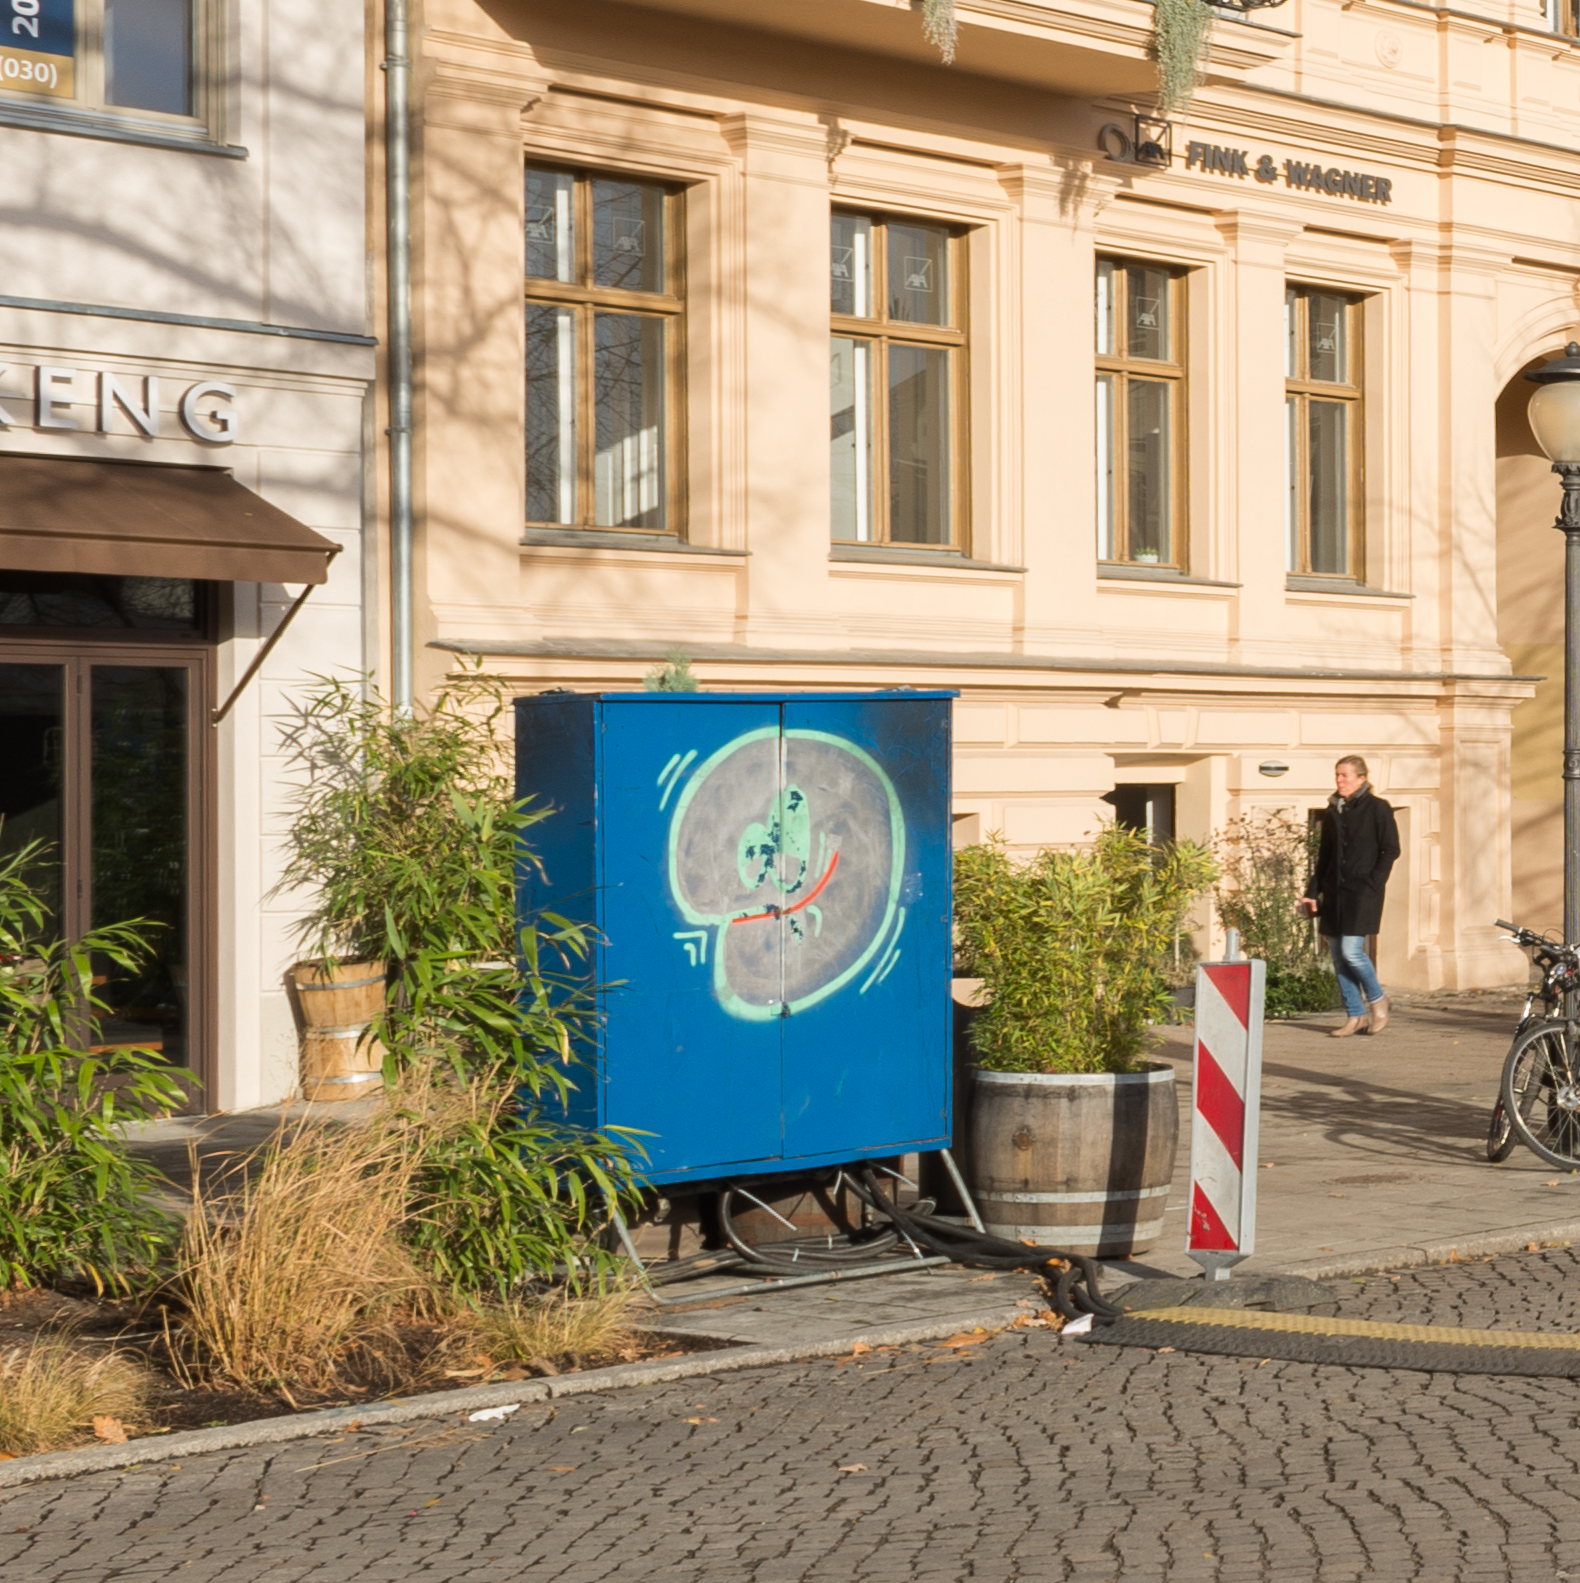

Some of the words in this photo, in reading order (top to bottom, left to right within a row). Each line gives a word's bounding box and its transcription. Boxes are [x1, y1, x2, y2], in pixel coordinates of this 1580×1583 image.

[1188, 139, 1250, 176] FINK
[1257, 154, 1278, 182] &
[1285, 158, 1392, 202] WAGNER
